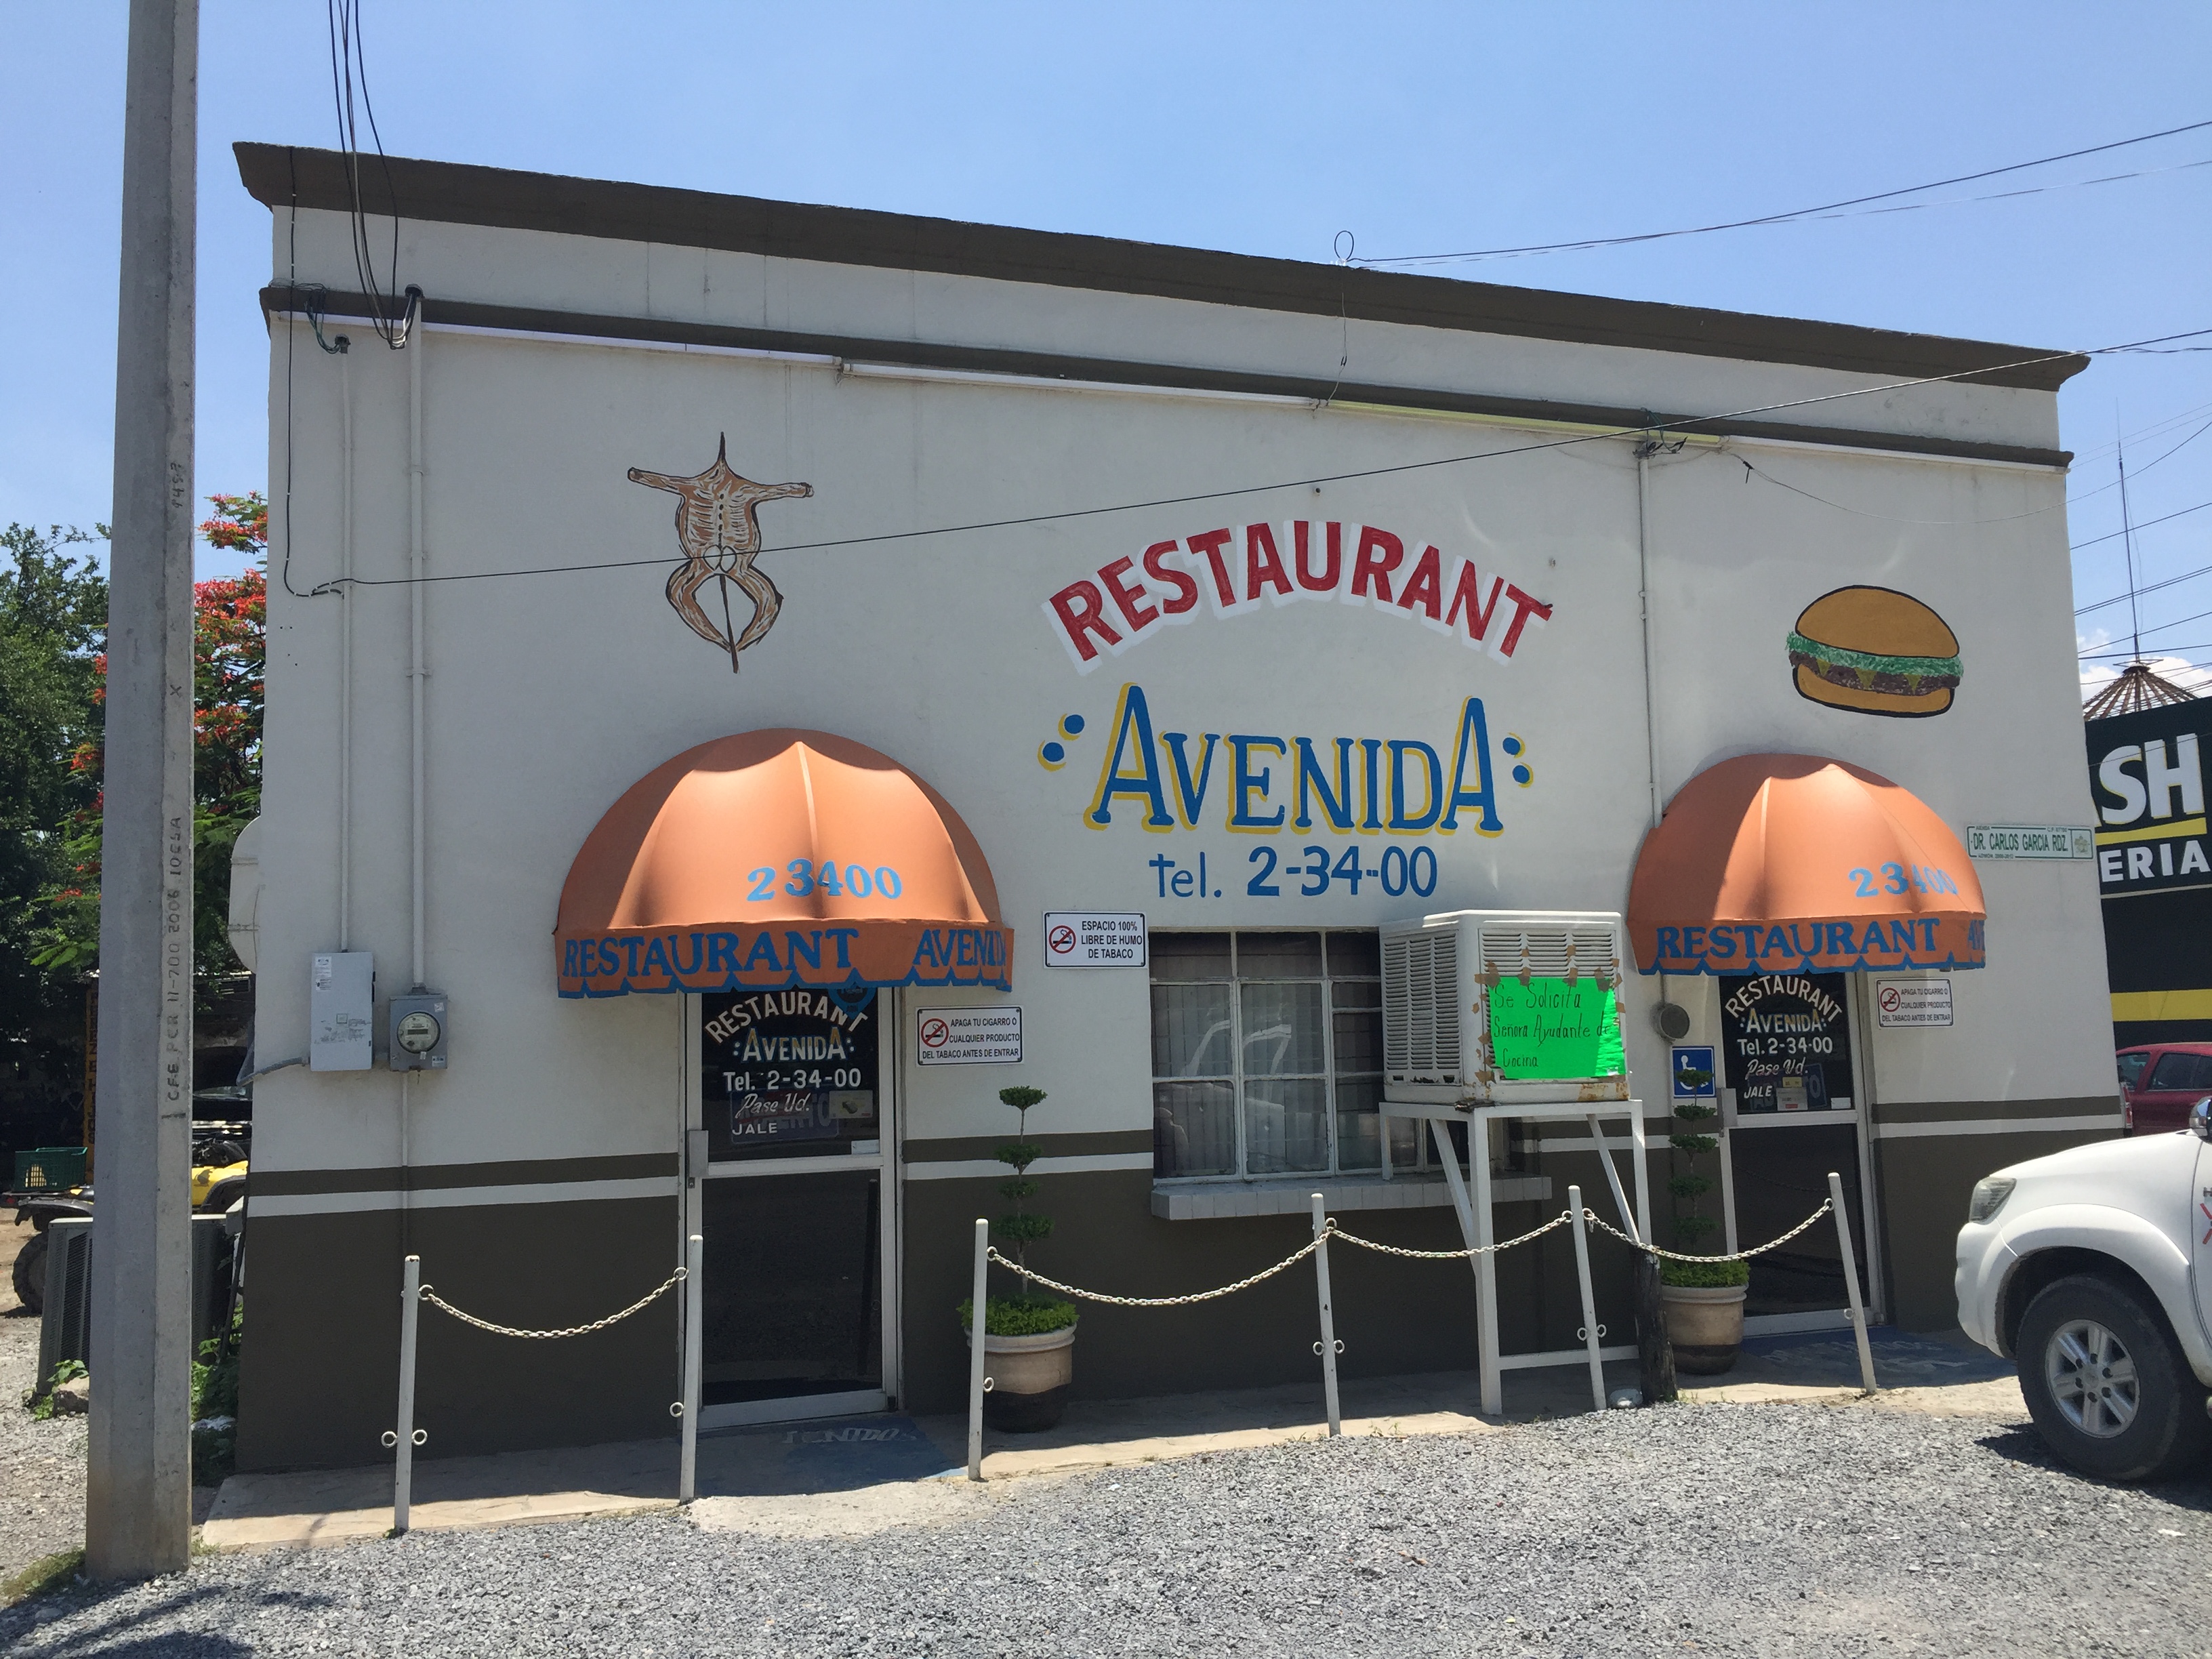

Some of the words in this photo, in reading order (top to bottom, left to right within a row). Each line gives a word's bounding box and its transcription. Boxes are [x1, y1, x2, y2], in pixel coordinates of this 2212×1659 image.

[1046, 520, 1553, 668] RESTAURANT
[1084, 682, 1504, 838] AVENIDA
[2094, 733, 2205, 826] SH
[1973, 833, 1986, 850] DR.
[1989, 833, 2019, 851] CARLOS
[2022, 834, 2050, 851] GARCIA
[2052, 834, 2068, 852] RDZ.
[745, 857, 903, 902] 23400
[1149, 851, 1223, 899] tel.
[1246, 845, 1438, 898] 2-34-00
[1082, 920, 1116, 931] ESPACIO
[1118, 920, 1138, 931] 100%
[1081, 935, 1105, 945] LIBRE
[1106, 935, 1118, 945] DE
[1119, 935, 1143, 945] HUMO
[1656, 918, 1940, 960] RESTAURANT
[562, 928, 860, 978] RESTAURANT
[1088, 948, 1099, 958] DE
[1101, 948, 1134, 958] TABACO
[1494, 983, 1514, 1008] Se
[1725, 975, 1843, 1022] RESTAURANT
[704, 991, 869, 1044] RESTAURANT
[950, 1018, 972, 1027] APAGA
[972, 1019, 981, 1027] TU
[982, 1017, 1010, 1026] CIGARRO
[1011, 1017, 1017, 1026] O
[1746, 1008, 1823, 1033] AVENIDA
[741, 1026, 848, 1063] AVENIDA
[949, 1034, 985, 1044] CUALQUIER
[986, 1033, 1020, 1042] PRODUCTO
[1737, 1038, 1765, 1055] Tel.
[1767, 1037, 1833, 1054] 2-34-00
[922, 1050, 935, 1059] DEL
[937, 1050, 962, 1059] TABACO
[962, 1049, 983, 1058] ANTES
[984, 1048, 993, 1057] DE
[994, 1048, 1019, 1057] ENTRAR
[1502, 1048, 1539, 1067] Cocina
[723, 1071, 756, 1092] Tel.
[767, 1068, 862, 1091] 2-34-00
[1744, 1059, 1780, 1080] Pase
[1744, 1085, 1773, 1099] JALE
[735, 1093, 779, 1119] Pase
[732, 1122, 779, 1136] JALE
